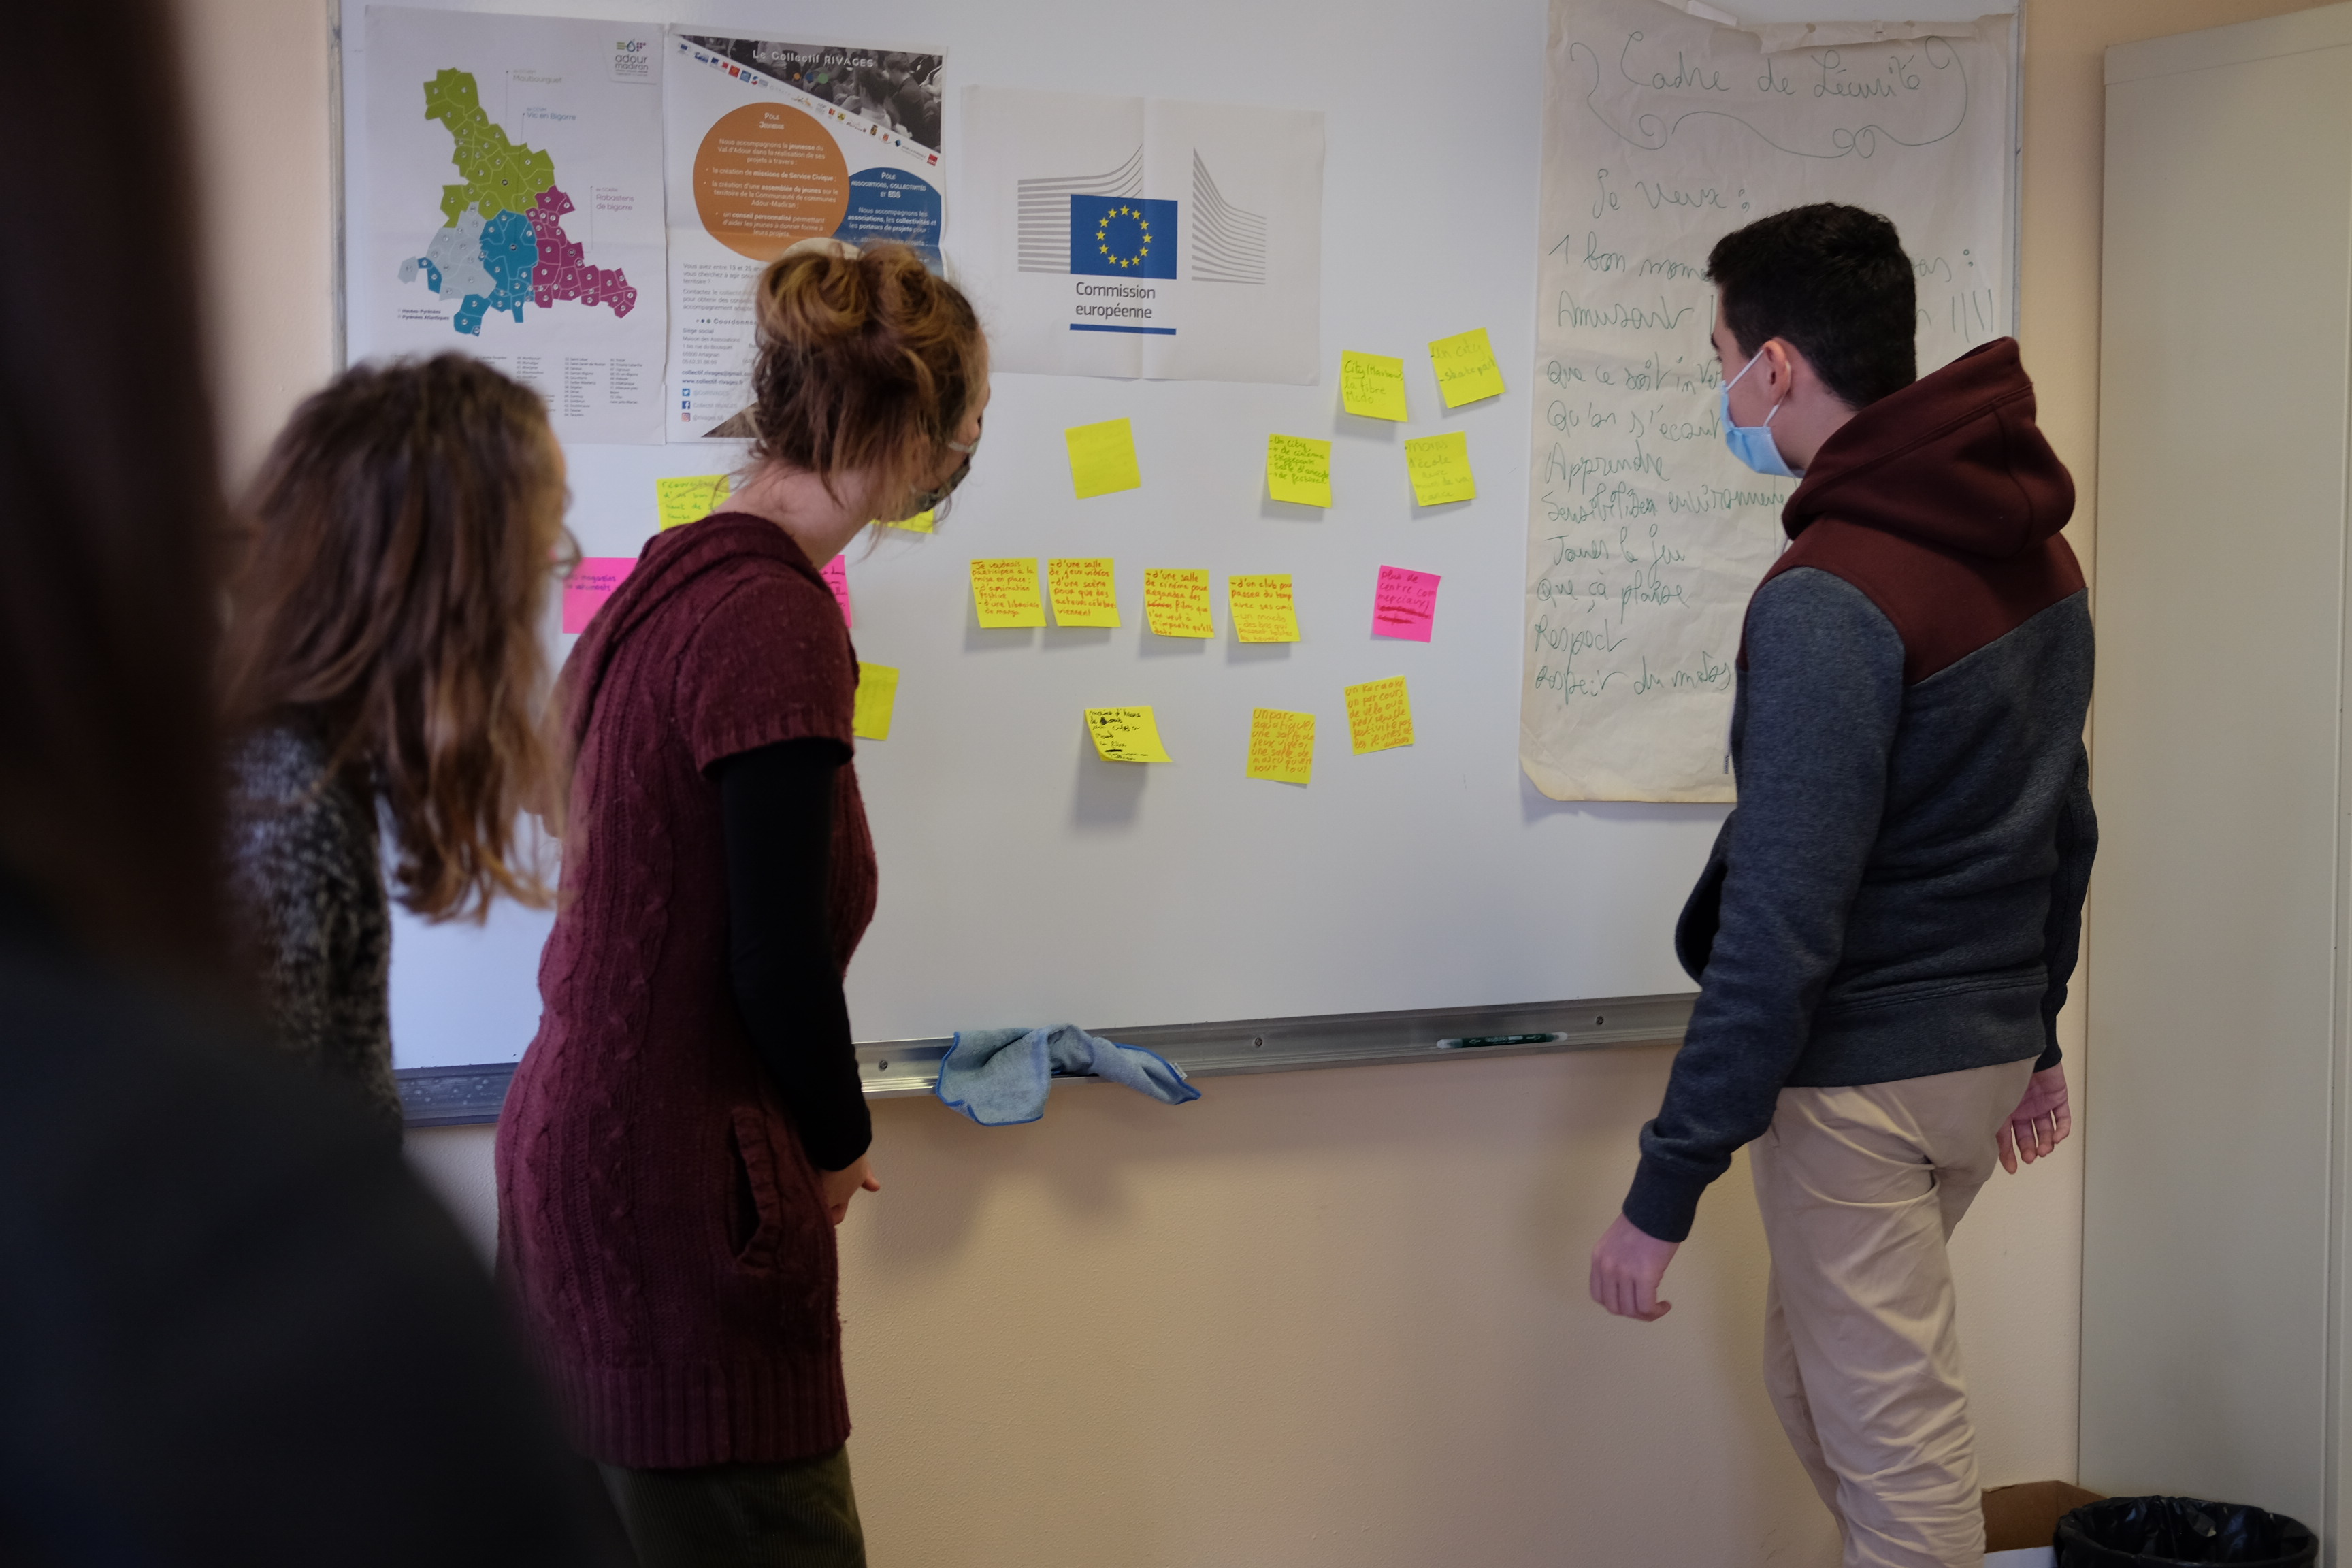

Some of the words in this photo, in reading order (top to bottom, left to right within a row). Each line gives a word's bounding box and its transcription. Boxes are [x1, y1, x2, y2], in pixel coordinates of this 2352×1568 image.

[615, 54, 648, 64] adour
[615, 63, 649, 71] madiran
[752, 50, 766, 59] Le
[771, 51, 819, 63] Collectif
[823, 55, 874, 67] RIVAGES
[1620, 31, 1731, 93] Cadre
[1757, 57, 1796, 95] de
[550, 113, 576, 121] Bigorre
[1583, 231, 1626, 273] bon
[1075, 281, 1156, 300] Commission
[1075, 302, 1153, 320] européenne
[1545, 439, 1669, 494] Apprendre
